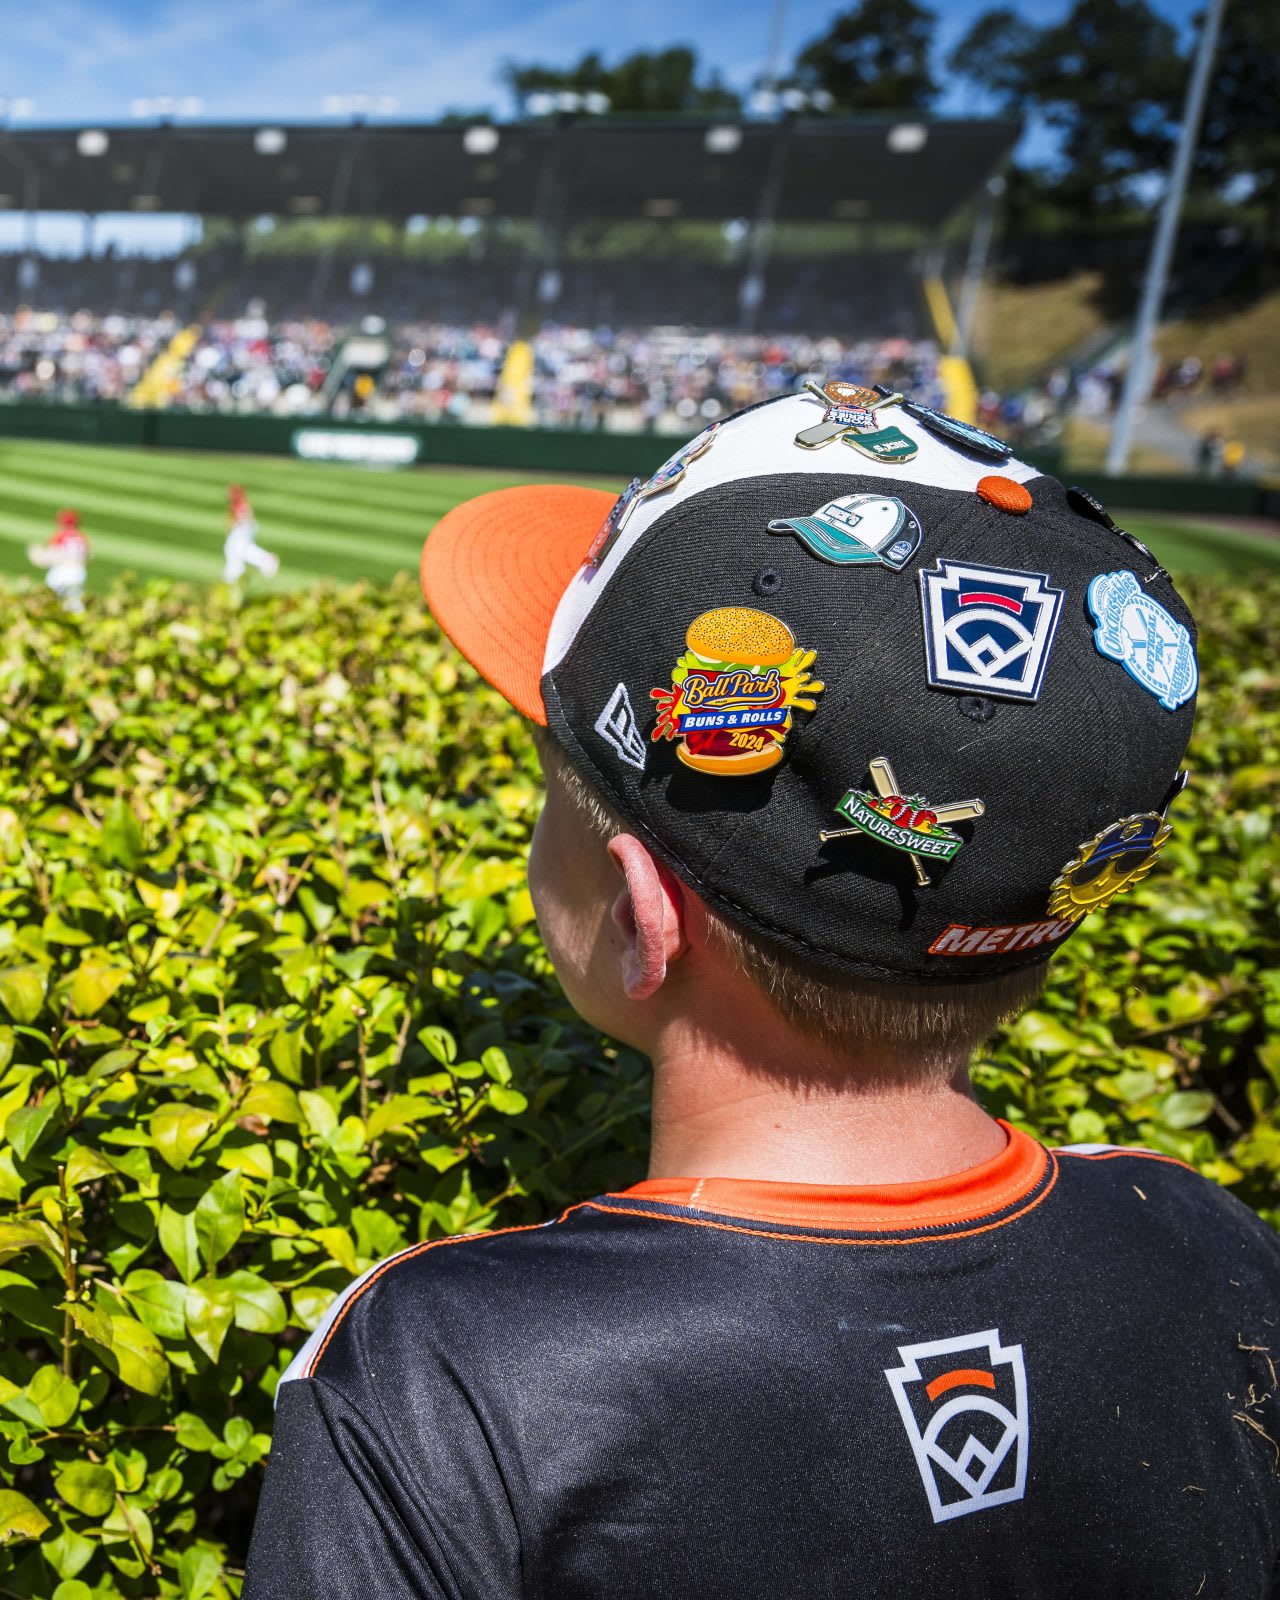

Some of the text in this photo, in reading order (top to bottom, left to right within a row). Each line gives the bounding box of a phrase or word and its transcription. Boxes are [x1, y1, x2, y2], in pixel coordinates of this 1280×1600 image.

[873, 439, 910, 453] DICK'S
[1146, 614, 1157, 673] OFFICIAL
[685, 672, 777, 705] Ball Park
[684, 711, 782, 728] BUNS & ROLLS
[729, 732, 765, 751] 2024
